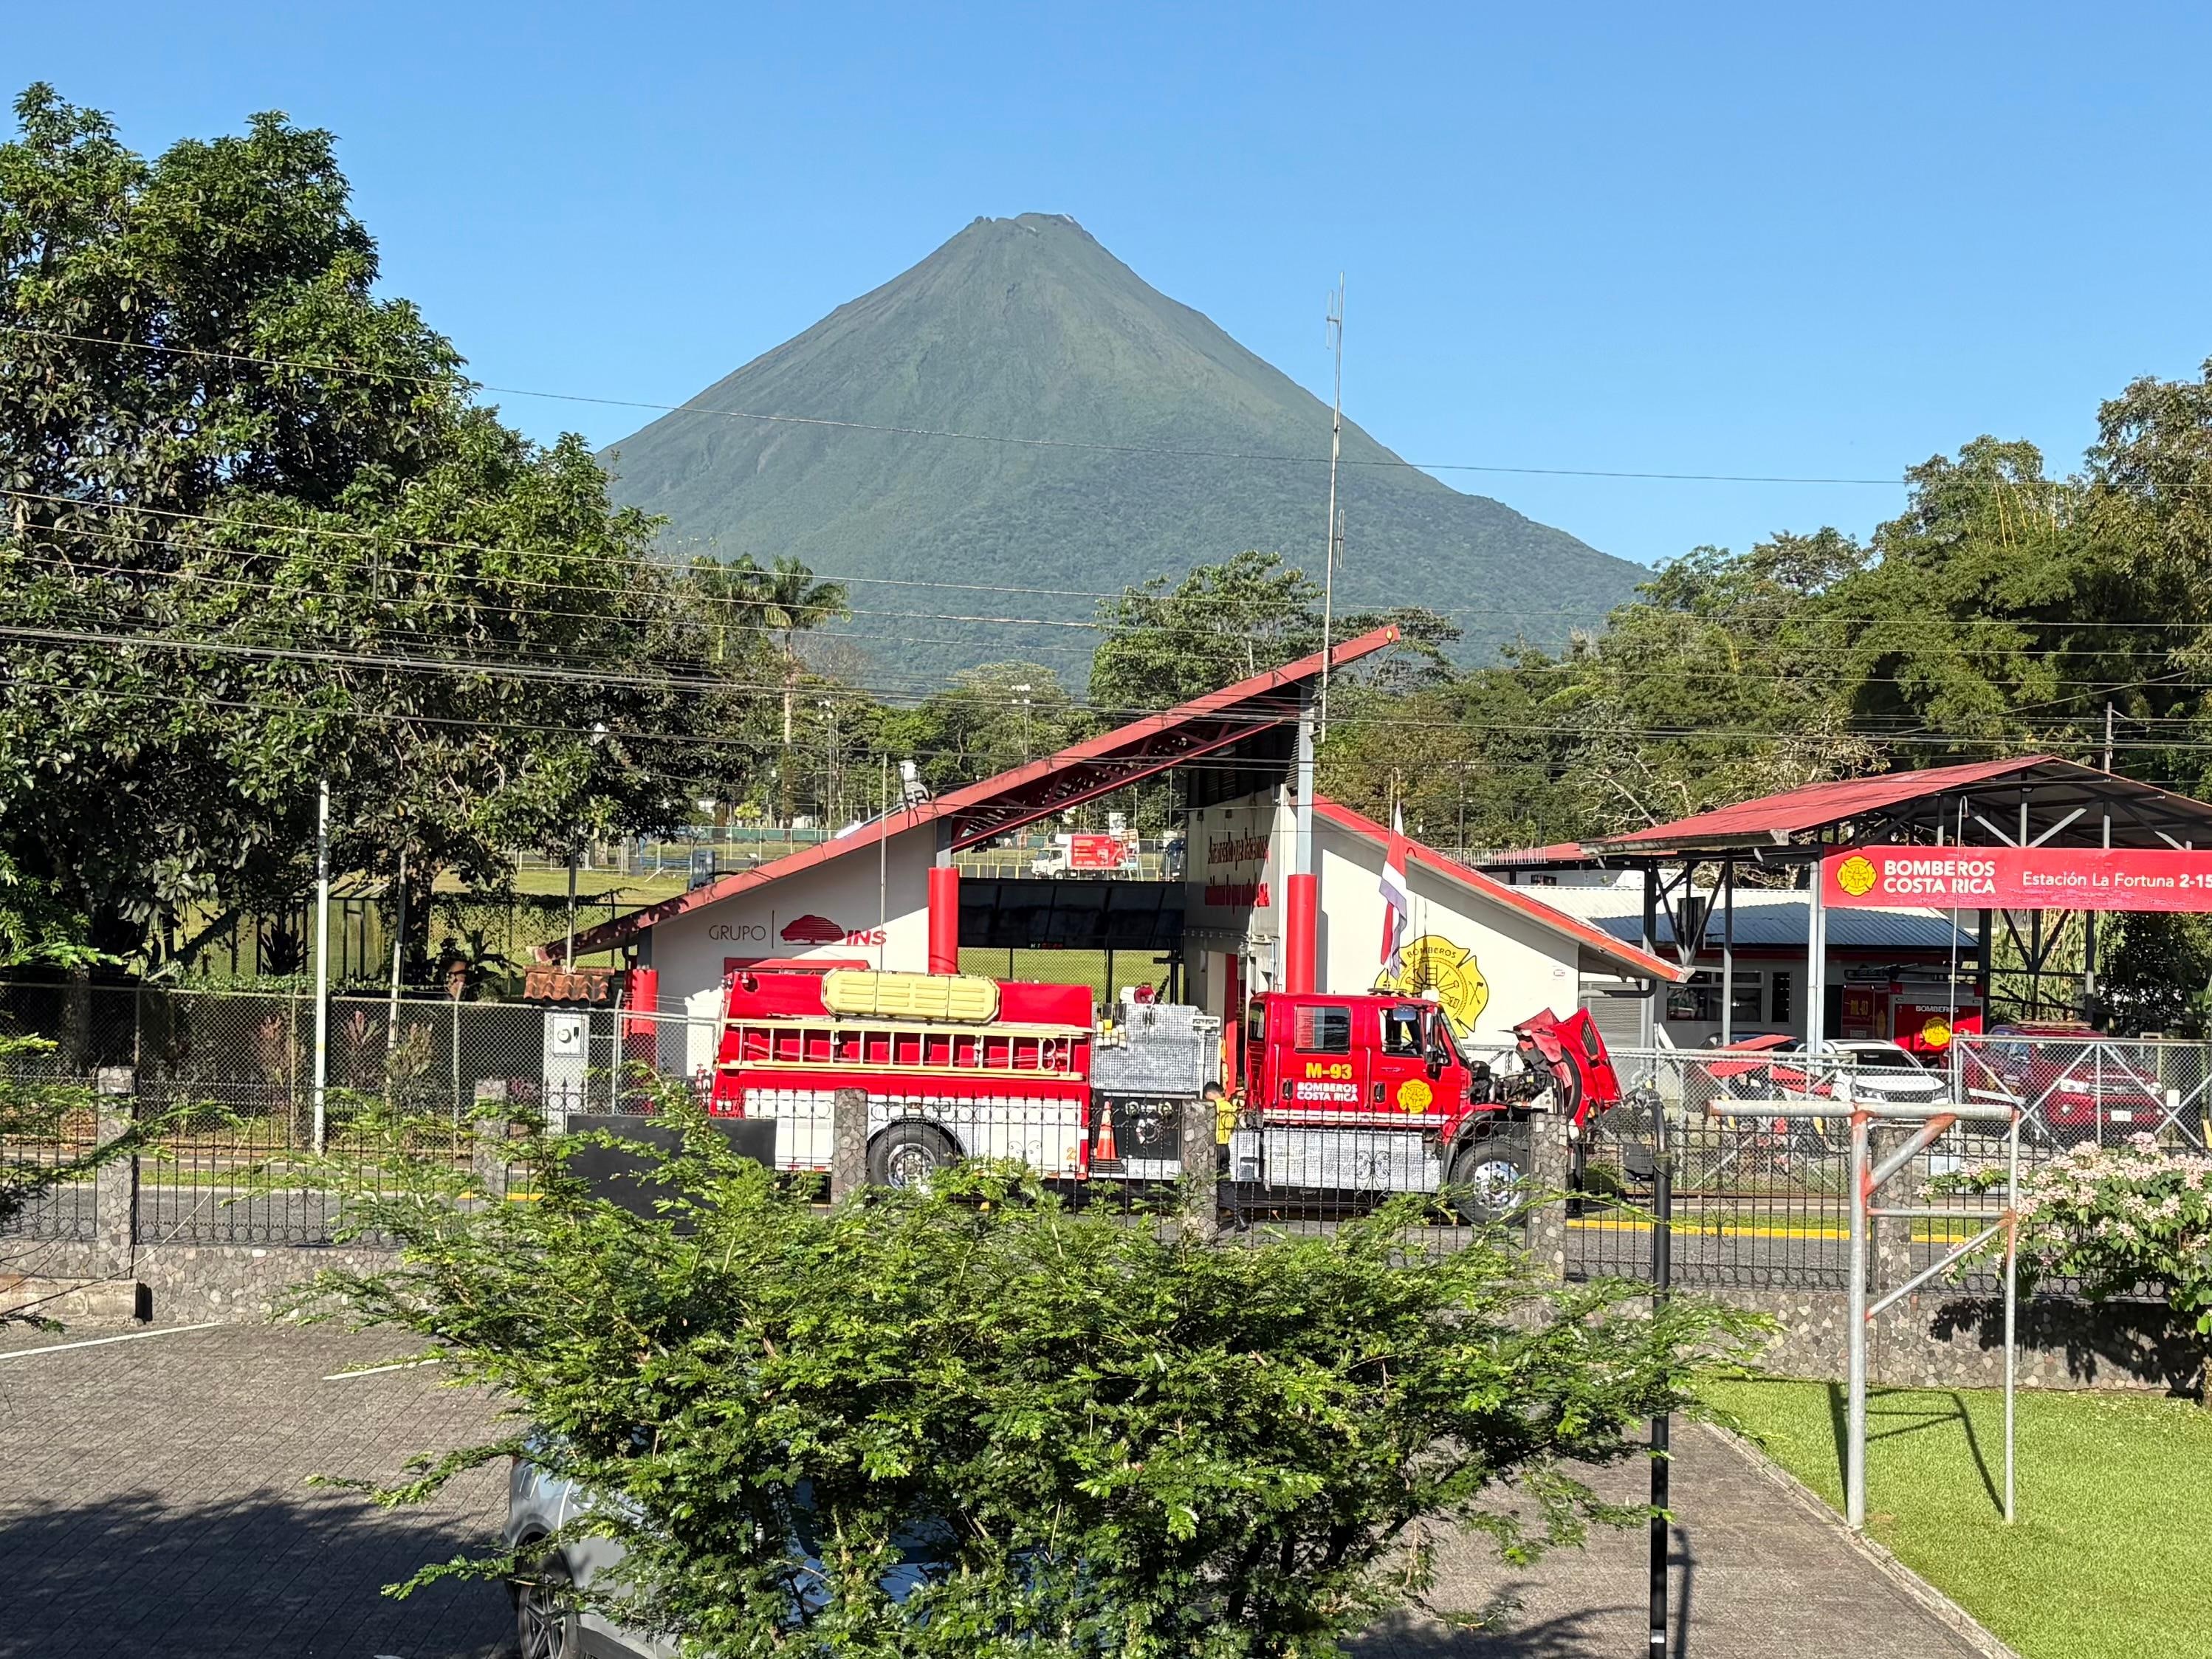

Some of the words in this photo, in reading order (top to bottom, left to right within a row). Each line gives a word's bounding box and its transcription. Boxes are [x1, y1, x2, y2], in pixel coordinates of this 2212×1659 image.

[1884, 859, 1996, 877] BOMBEROS
[1883, 877, 1946, 893] COSTA
[1951, 879, 1996, 894] RICA
[2022, 871, 2087, 887] Estación
[2092, 873, 2109, 887] La
[2115, 873, 2174, 887] Fortuna
[708, 924, 766, 941] GRUPO
[846, 929, 887, 947] INS
[1406, 947, 1457, 959] BOMBEROS
[1915, 1005, 1959, 1014] BOMBERS
[1305, 1062, 1352, 1079] M-93
[1297, 1082, 1358, 1093] BOMBEROS
[1296, 1091, 1331, 1101] COSTA
[1333, 1093, 1359, 1102] RICA
